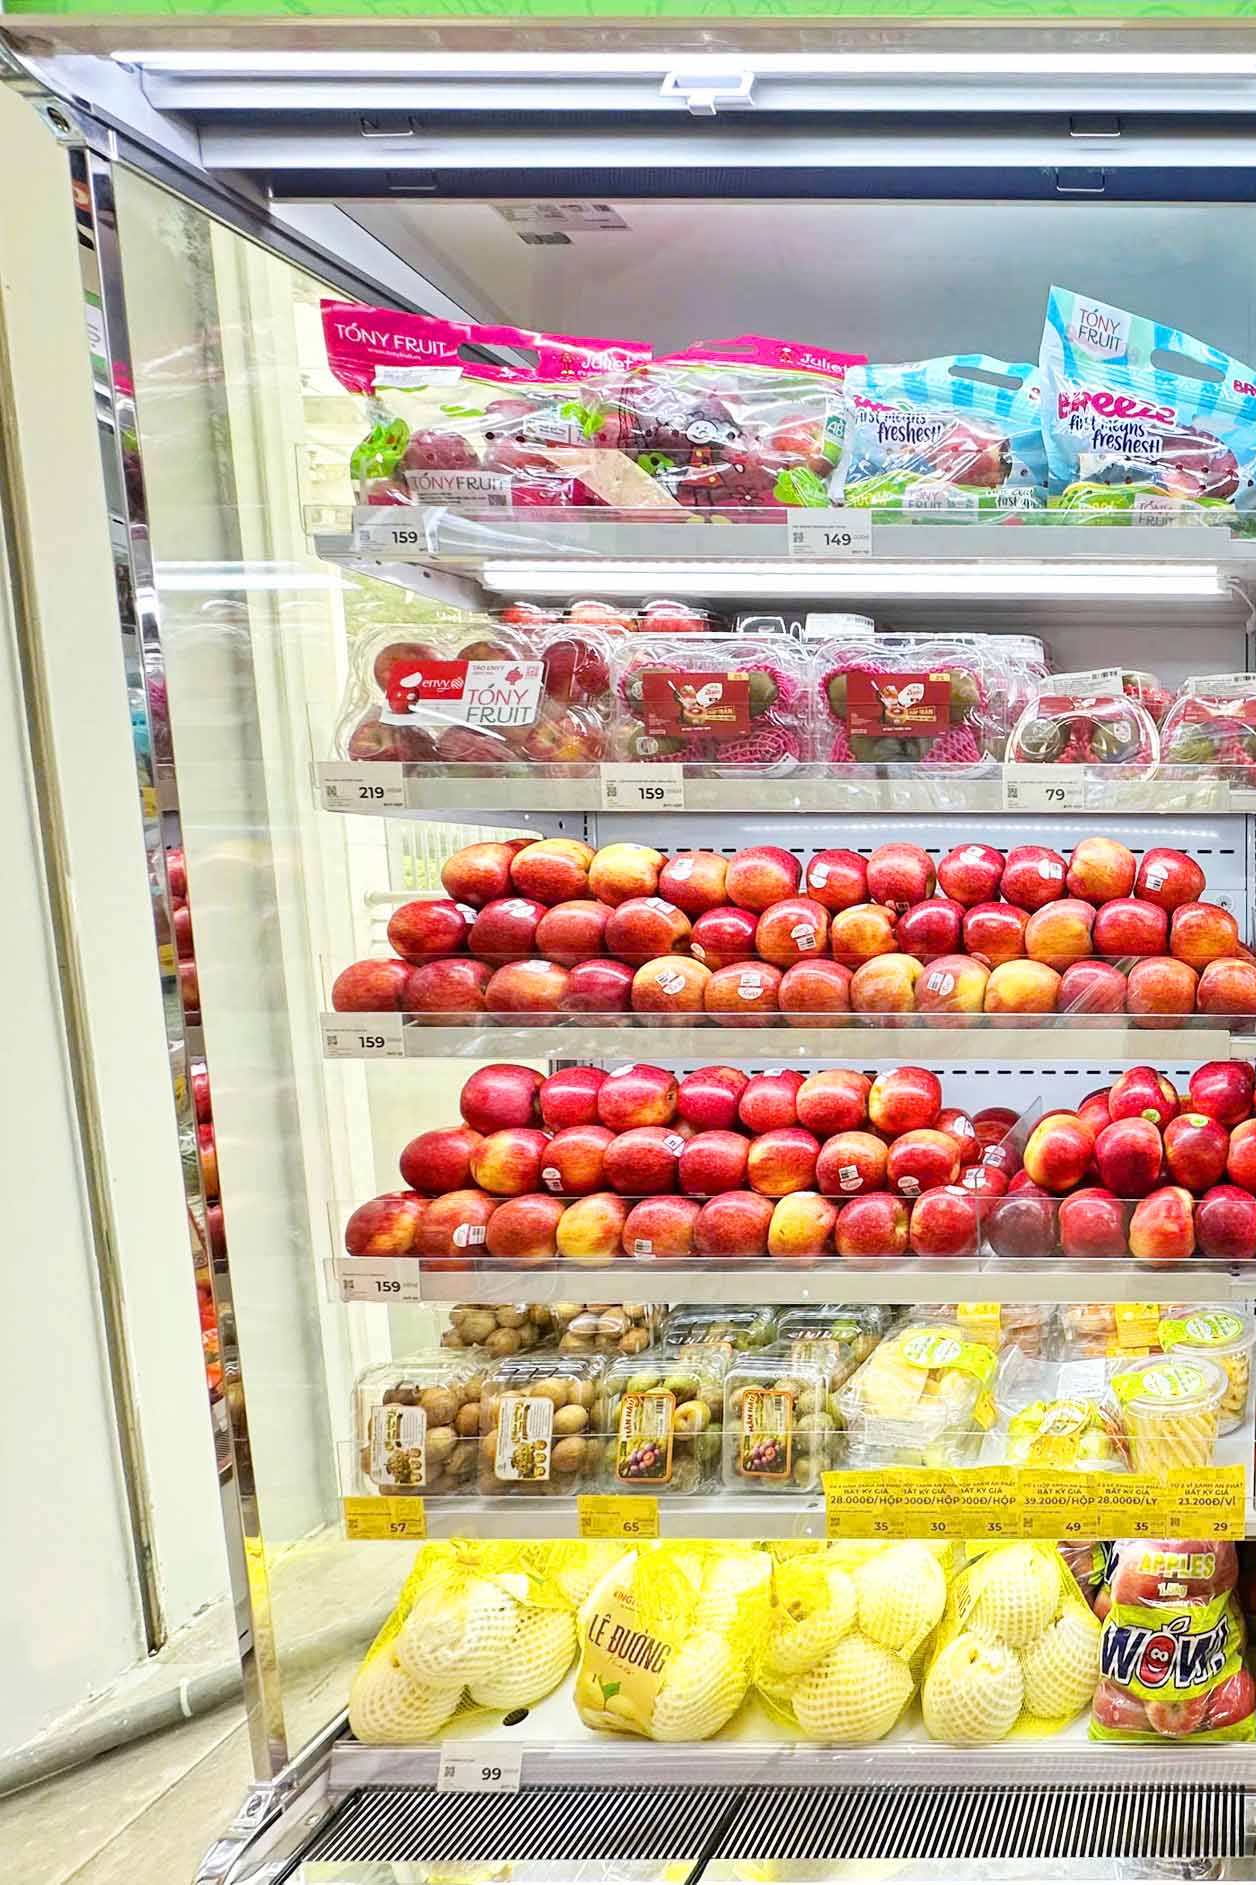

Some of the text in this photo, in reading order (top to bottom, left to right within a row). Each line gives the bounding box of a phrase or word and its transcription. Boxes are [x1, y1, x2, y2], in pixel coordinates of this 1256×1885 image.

[1079, 308, 1121, 334] TÓNY
[334, 322, 448, 356] TÓNY FRUIT
[1077, 325, 1121, 352] FRUIT
[391, 531, 418, 544] 159
[824, 533, 851, 546] 149
[467, 683, 529, 705] TÓNY
[465, 706, 532, 724] FRUIT
[359, 786, 385, 799] 219
[638, 786, 665, 800] 159
[1045, 788, 1065, 801] 79
[358, 1036, 385, 1048] 159
[375, 1281, 400, 1293] 159
[390, 1523, 406, 1532] 57
[623, 1522, 639, 1532] 65
[874, 1522, 889, 1531] 35
[930, 1522, 946, 1531] 30
[987, 1522, 1003, 1531] 35
[1065, 1522, 1081, 1531] 49
[1134, 1522, 1149, 1531] 35
[1213, 1522, 1228, 1531] 29
[1138, 1552, 1216, 1580] APPLES
[588, 1613, 612, 1647] LÊ
[1099, 1615, 1230, 1689] WOW!
[481, 1767, 502, 1780] 99
